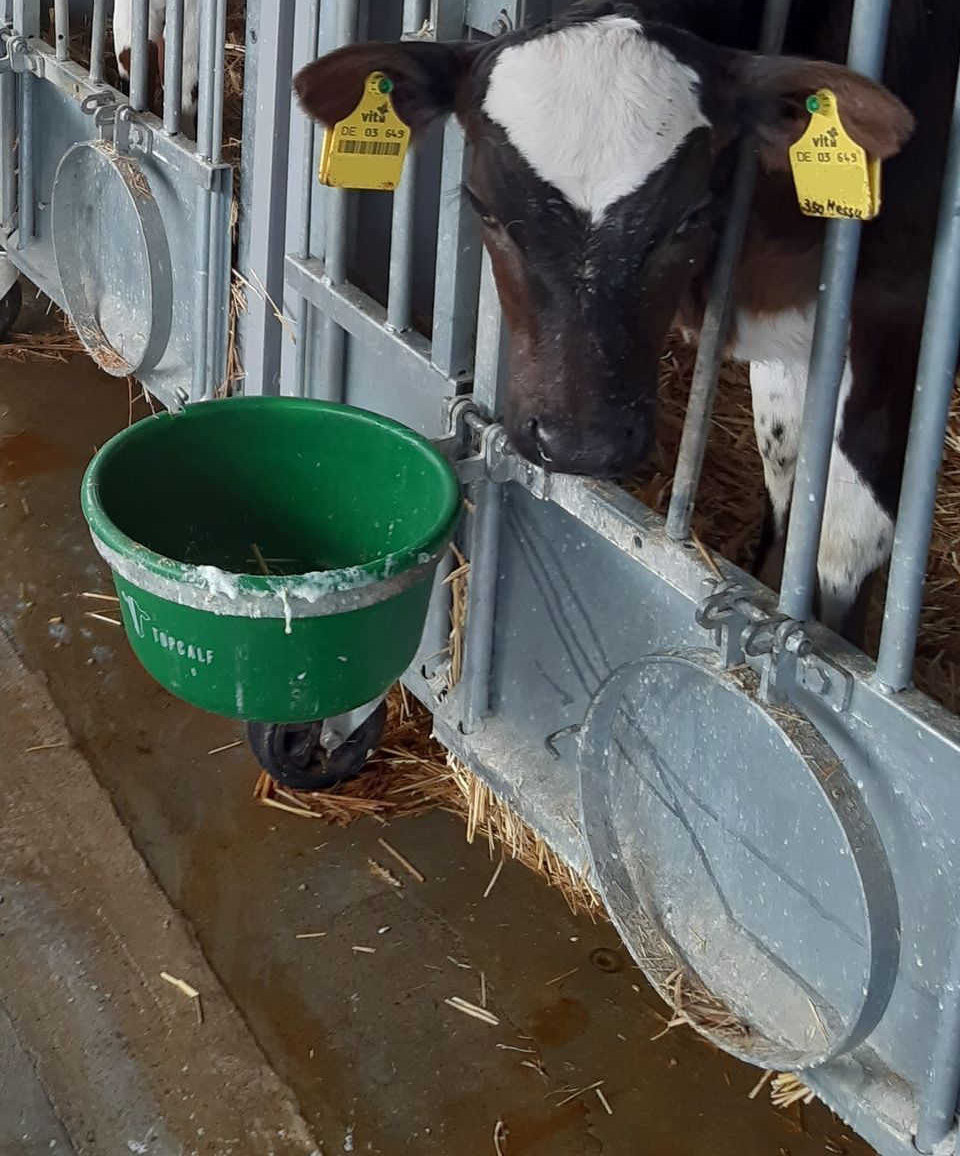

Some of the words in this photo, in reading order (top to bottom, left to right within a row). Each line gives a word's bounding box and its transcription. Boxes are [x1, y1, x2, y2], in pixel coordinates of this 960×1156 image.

[341, 125, 357, 136] DE
[365, 128, 378, 138] 03
[385, 128, 404, 138] 649
[796, 151, 812, 162] DE
[817, 152, 831, 162] 03
[837, 152, 857, 162] 649
[151, 627, 214, 665] TOPCALF
